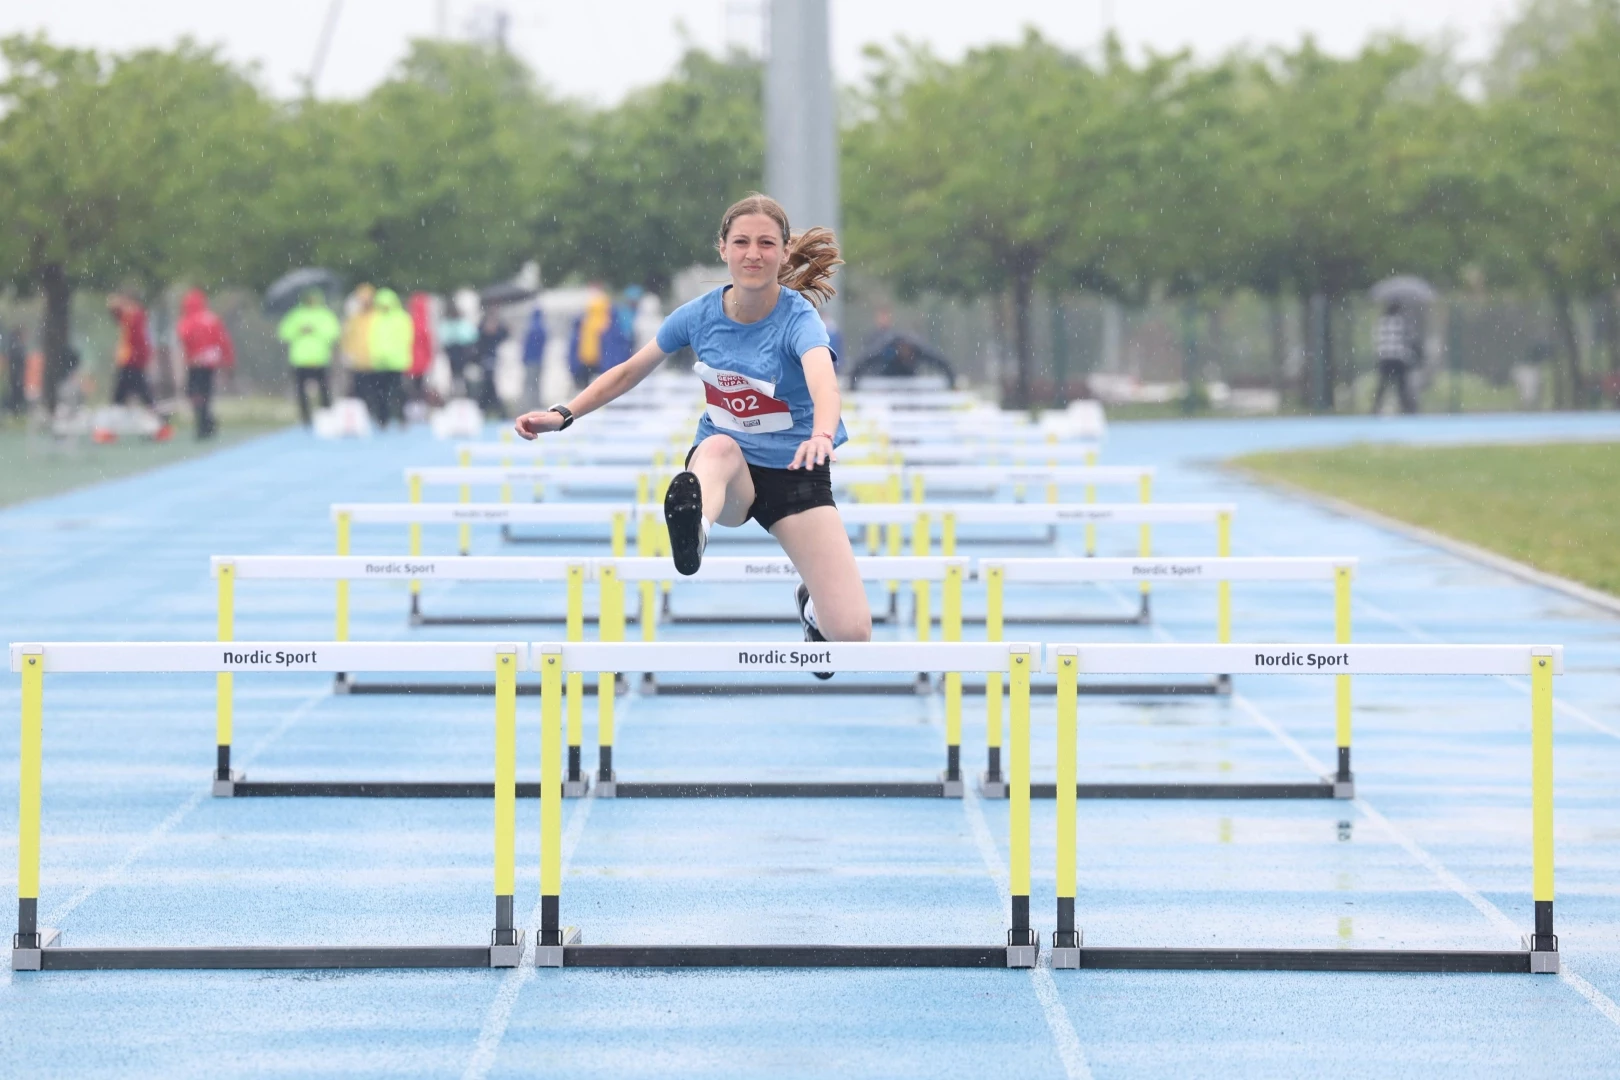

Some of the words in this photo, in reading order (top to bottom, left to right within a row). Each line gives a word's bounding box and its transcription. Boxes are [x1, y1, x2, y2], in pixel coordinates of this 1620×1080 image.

[723, 395, 759, 412] 102
[275, 651, 317, 667] Sport
[790, 651, 831, 667] Sport
[1307, 653, 1349, 669] Sport
